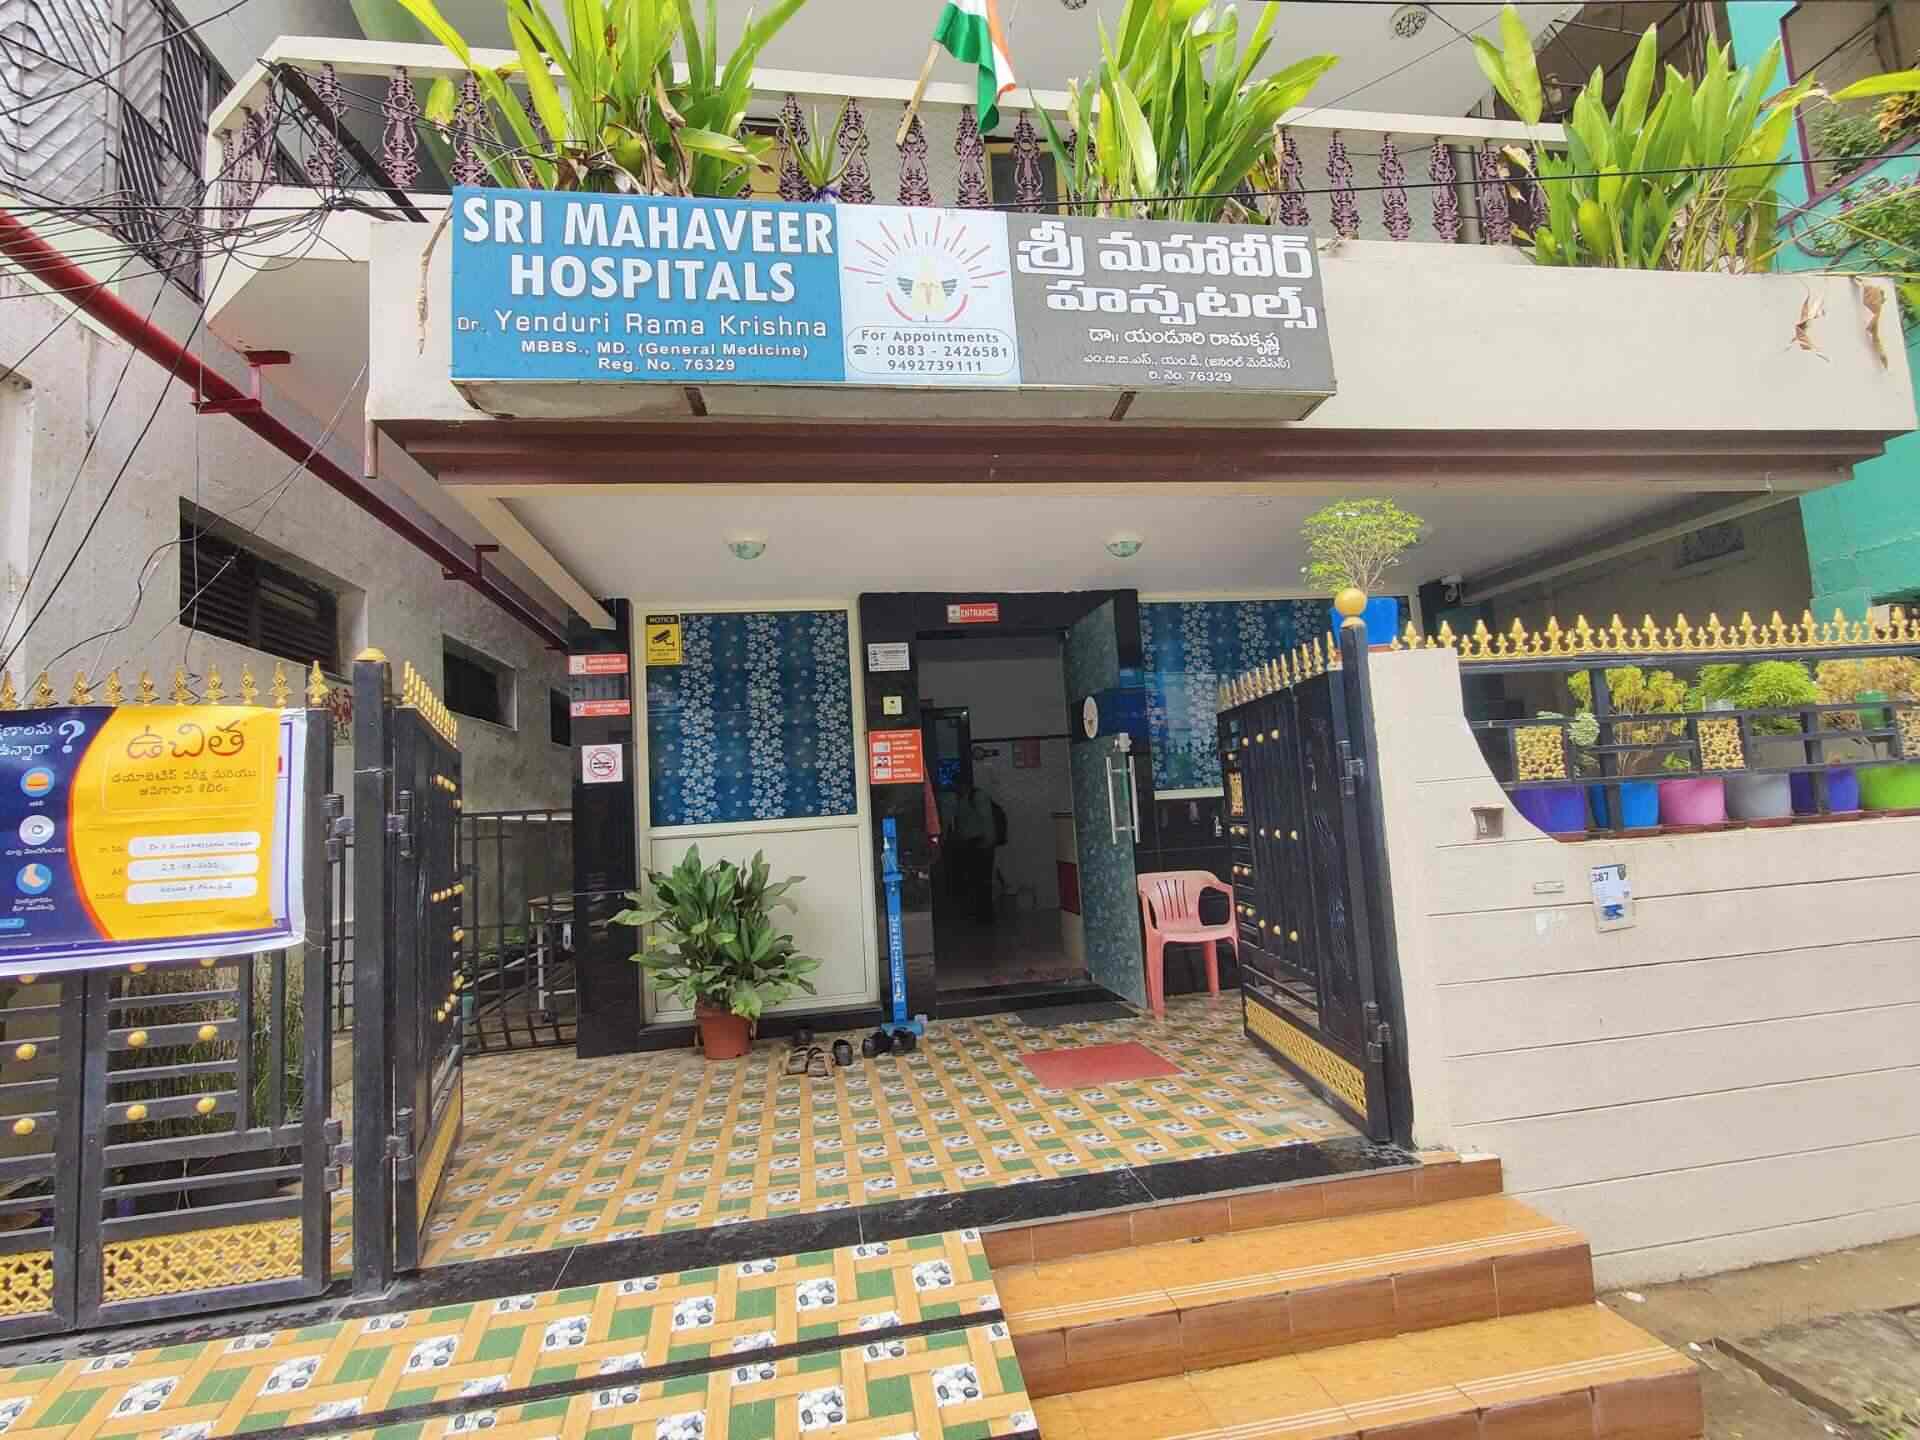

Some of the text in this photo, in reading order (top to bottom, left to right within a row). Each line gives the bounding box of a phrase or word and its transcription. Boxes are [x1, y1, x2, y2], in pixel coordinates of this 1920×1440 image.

[462, 197, 834, 255] SRI MAHAVEER
[1016, 220, 1314, 279] శ్రీ మహావీర్
[510, 253, 796, 303] HOSPITALS
[1046, 279, 1319, 329] హాస్పటల్స్
[457, 309, 827, 338] Dr. Yenduri Rama Krishna
[861, 329, 999, 344] For Appointments
[520, 340, 809, 359] MBBS., MD. (General Medicine)
[887, 344, 926, 357] 0883
[944, 345, 1008, 358] 2426581
[1124, 328, 1206, 346] యండూరి
[1209, 329, 1281, 355] రామకృష్ణ
[598, 357, 736, 373] Reg. No. 76329
[887, 359, 983, 373] 9492739111
[1188, 371, 1233, 383] 76329
[127, 720, 245, 760] ఉచిత
